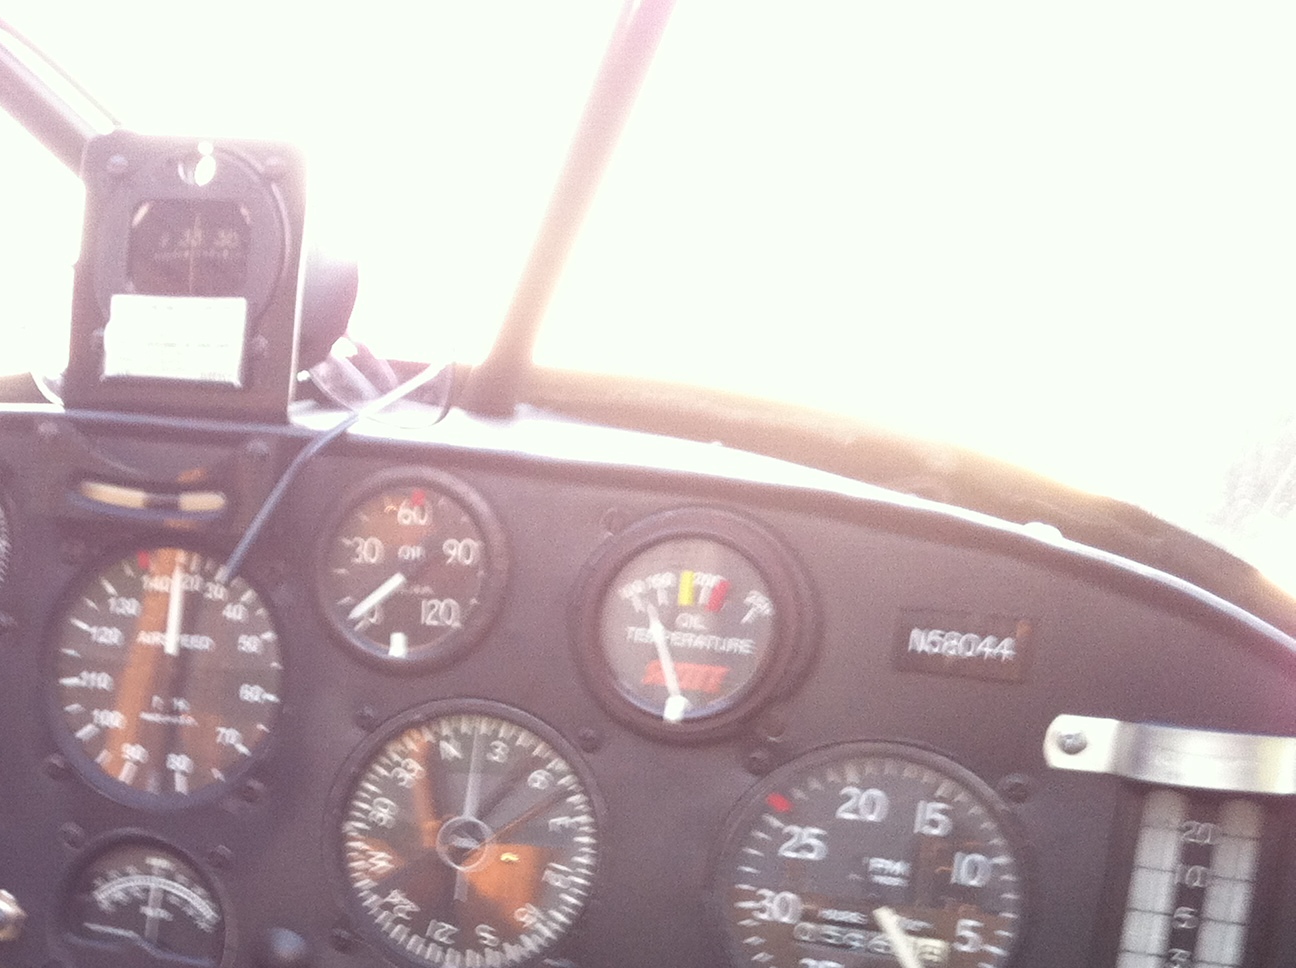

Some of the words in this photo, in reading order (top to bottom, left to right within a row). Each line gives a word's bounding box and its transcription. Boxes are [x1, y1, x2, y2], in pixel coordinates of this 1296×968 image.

[397, 500, 432, 526] 60
[354, 537, 384, 564] 30
[442, 538, 480, 565] 90
[109, 596, 141, 616] 130
[223, 602, 248, 622] 40
[421, 599, 461, 627] 120
[91, 626, 124, 646] 120
[237, 634, 262, 653] 50
[79, 671, 113, 690] 110
[239, 684, 264, 703] 60
[92, 709, 126, 729] 100
[216, 727, 242, 746] 70
[121, 743, 149, 763] 90
[166, 754, 194, 774] 80
[486, 741, 509, 763] 3
[392, 758, 424, 788] 33
[835, 786, 889, 823] 20
[914, 800, 953, 837] 15
[777, 825, 828, 861] 25
[1181, 821, 1217, 845] 20
[951, 852, 992, 888] 10
[1175, 864, 1207, 889] 10
[754, 889, 802, 923] 30
[475, 924, 500, 947] S
[955, 919, 984, 952] 5
